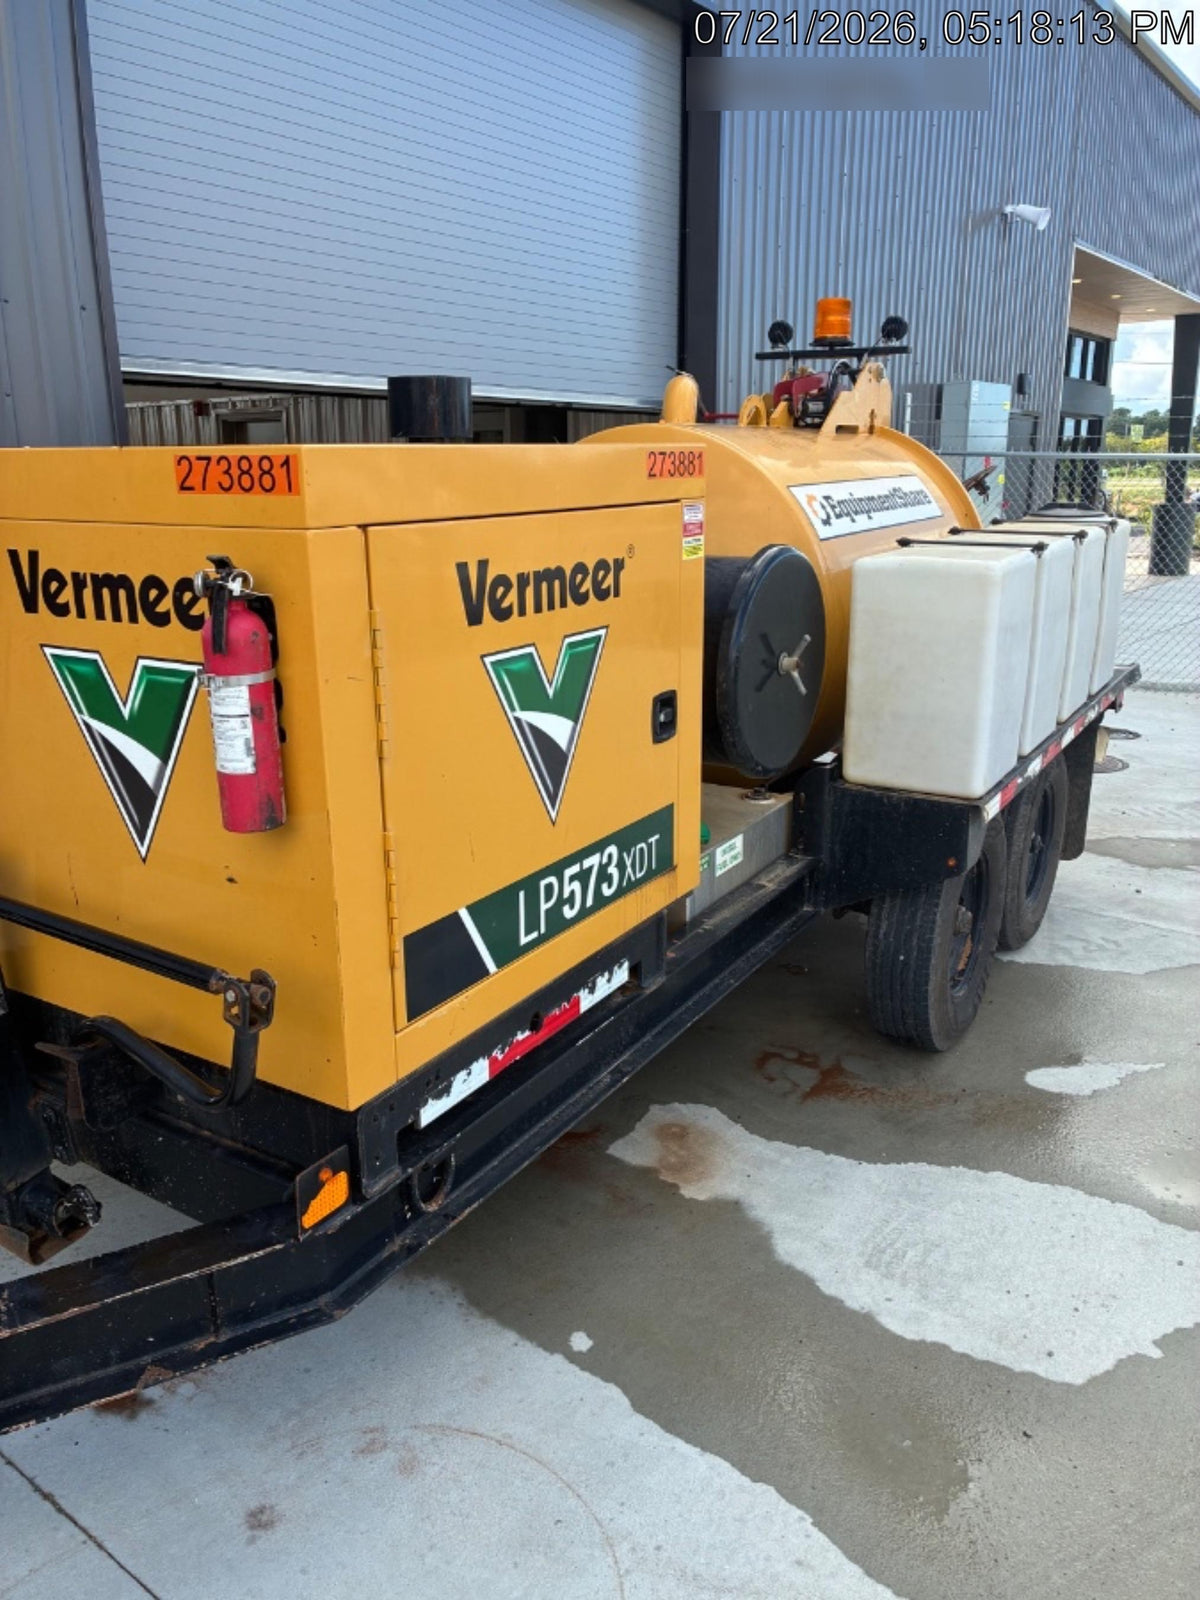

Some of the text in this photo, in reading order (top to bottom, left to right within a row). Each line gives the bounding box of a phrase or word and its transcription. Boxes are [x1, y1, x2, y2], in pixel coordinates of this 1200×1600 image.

[176, 454, 293, 493] 273881
[648, 450, 703, 478] 273881
[822, 486, 932, 523] EquipmentShare
[7, 548, 213, 631] Vermee
[455, 558, 625, 627] Vermeer
